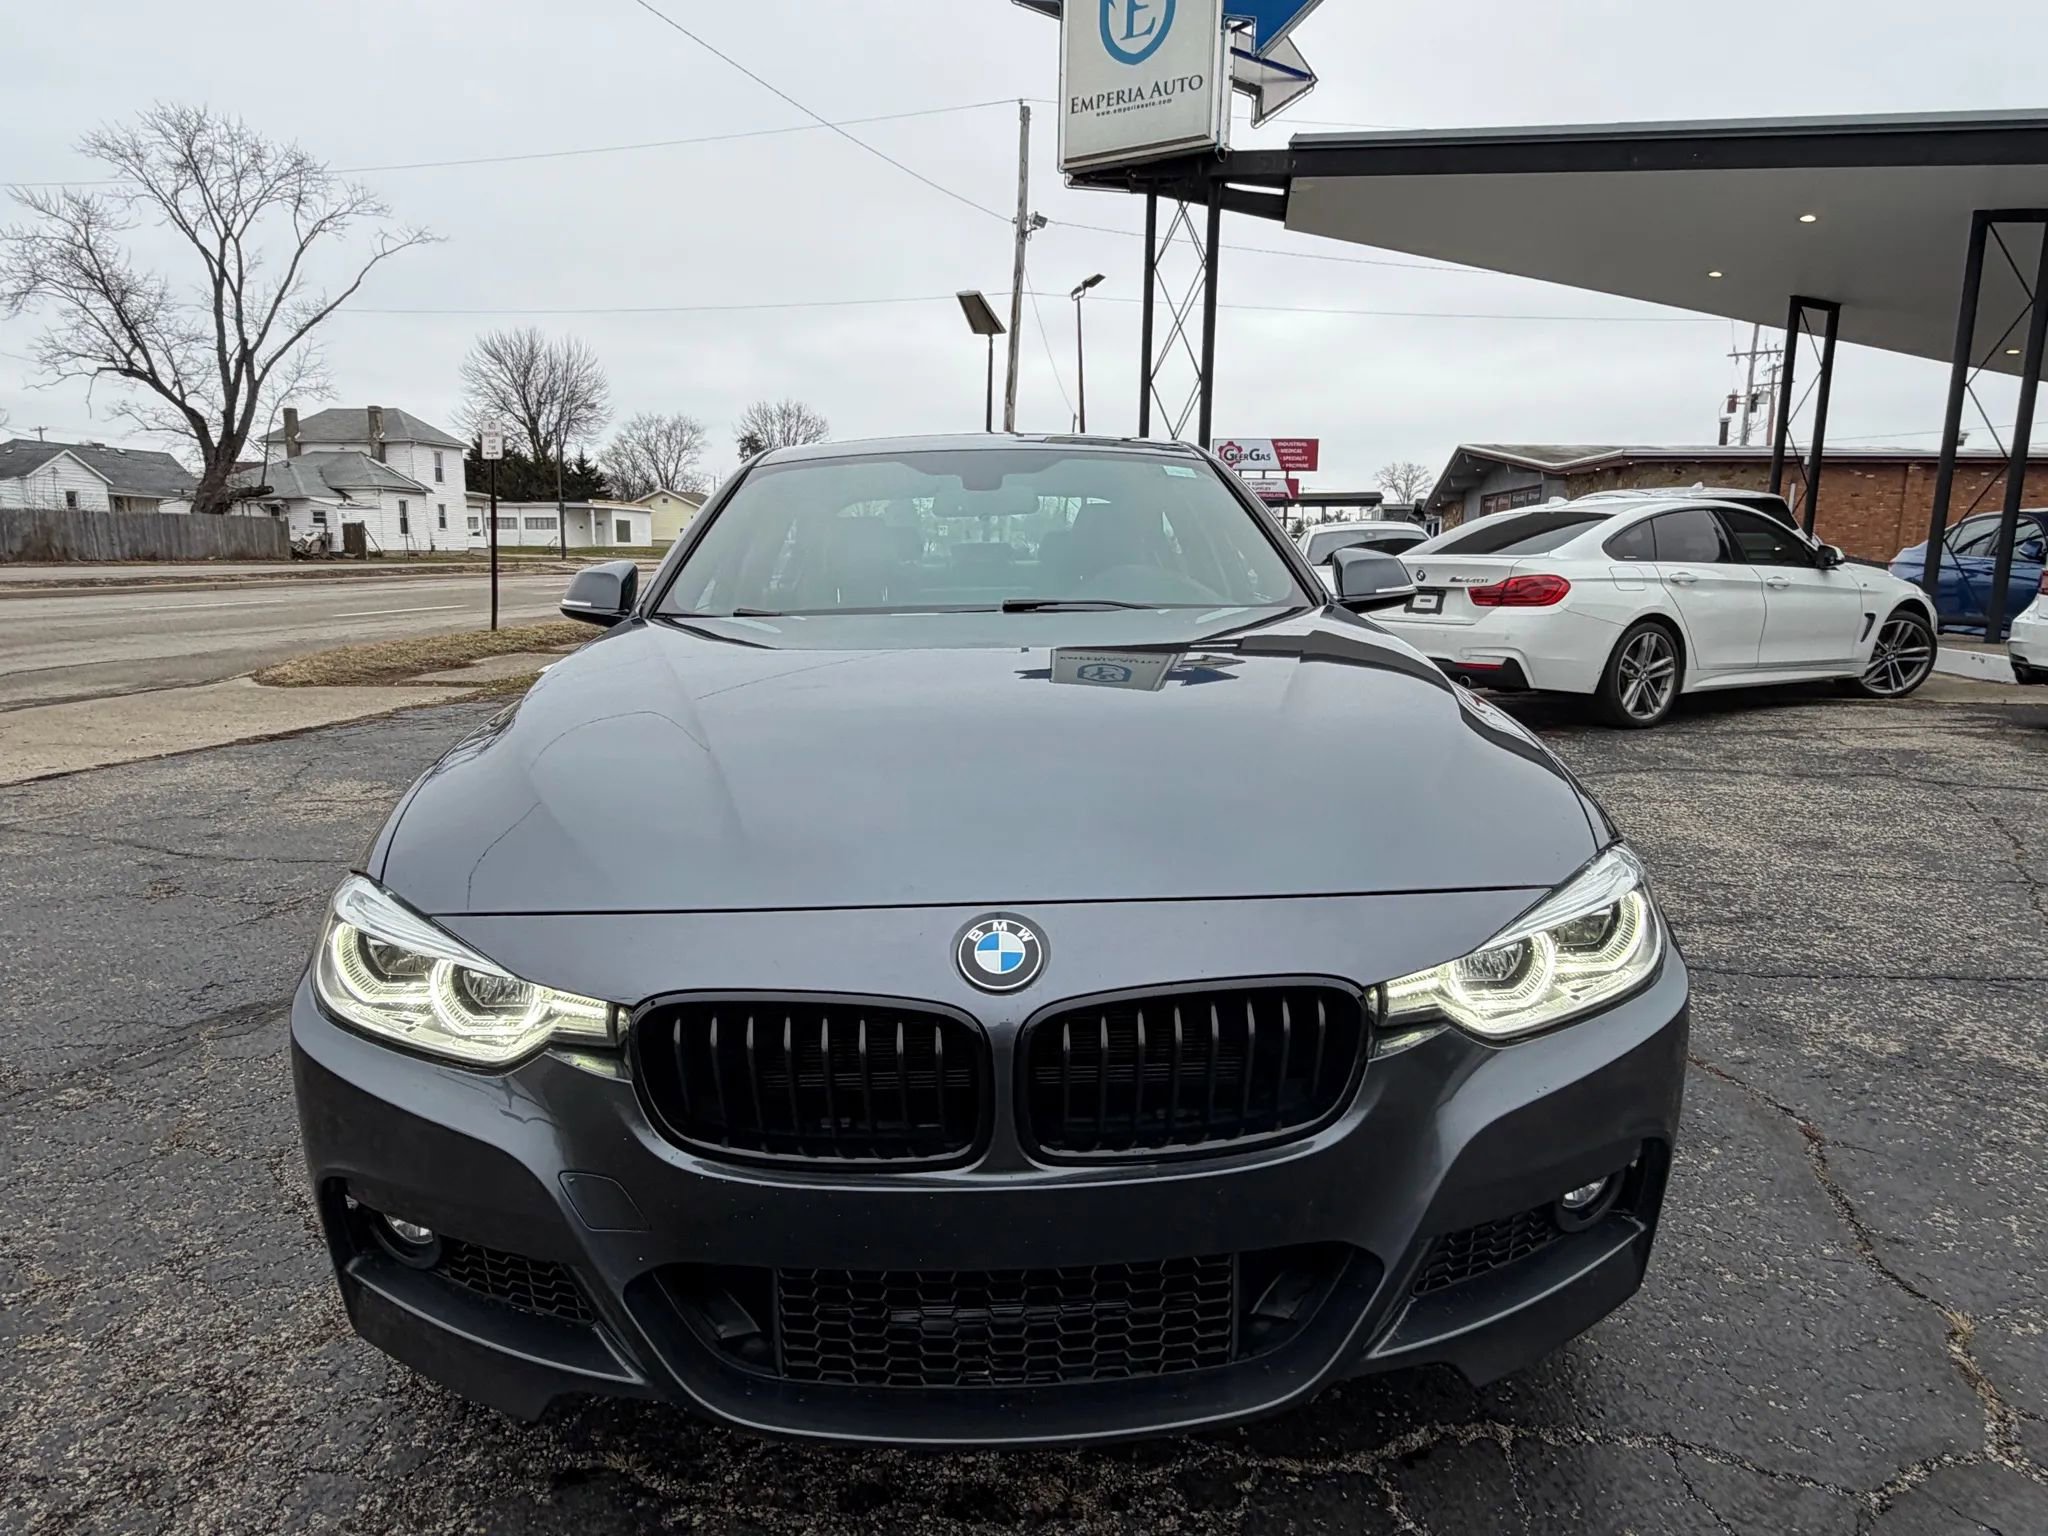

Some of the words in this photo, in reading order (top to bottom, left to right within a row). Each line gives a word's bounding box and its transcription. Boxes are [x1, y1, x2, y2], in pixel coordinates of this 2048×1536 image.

[1070, 85, 1145, 115] EMPERIA
[1149, 74, 1204, 99] AUTO
[1096, 98, 1173, 117] www.emperiaauto.com
[967, 920, 1034, 942] BMW
